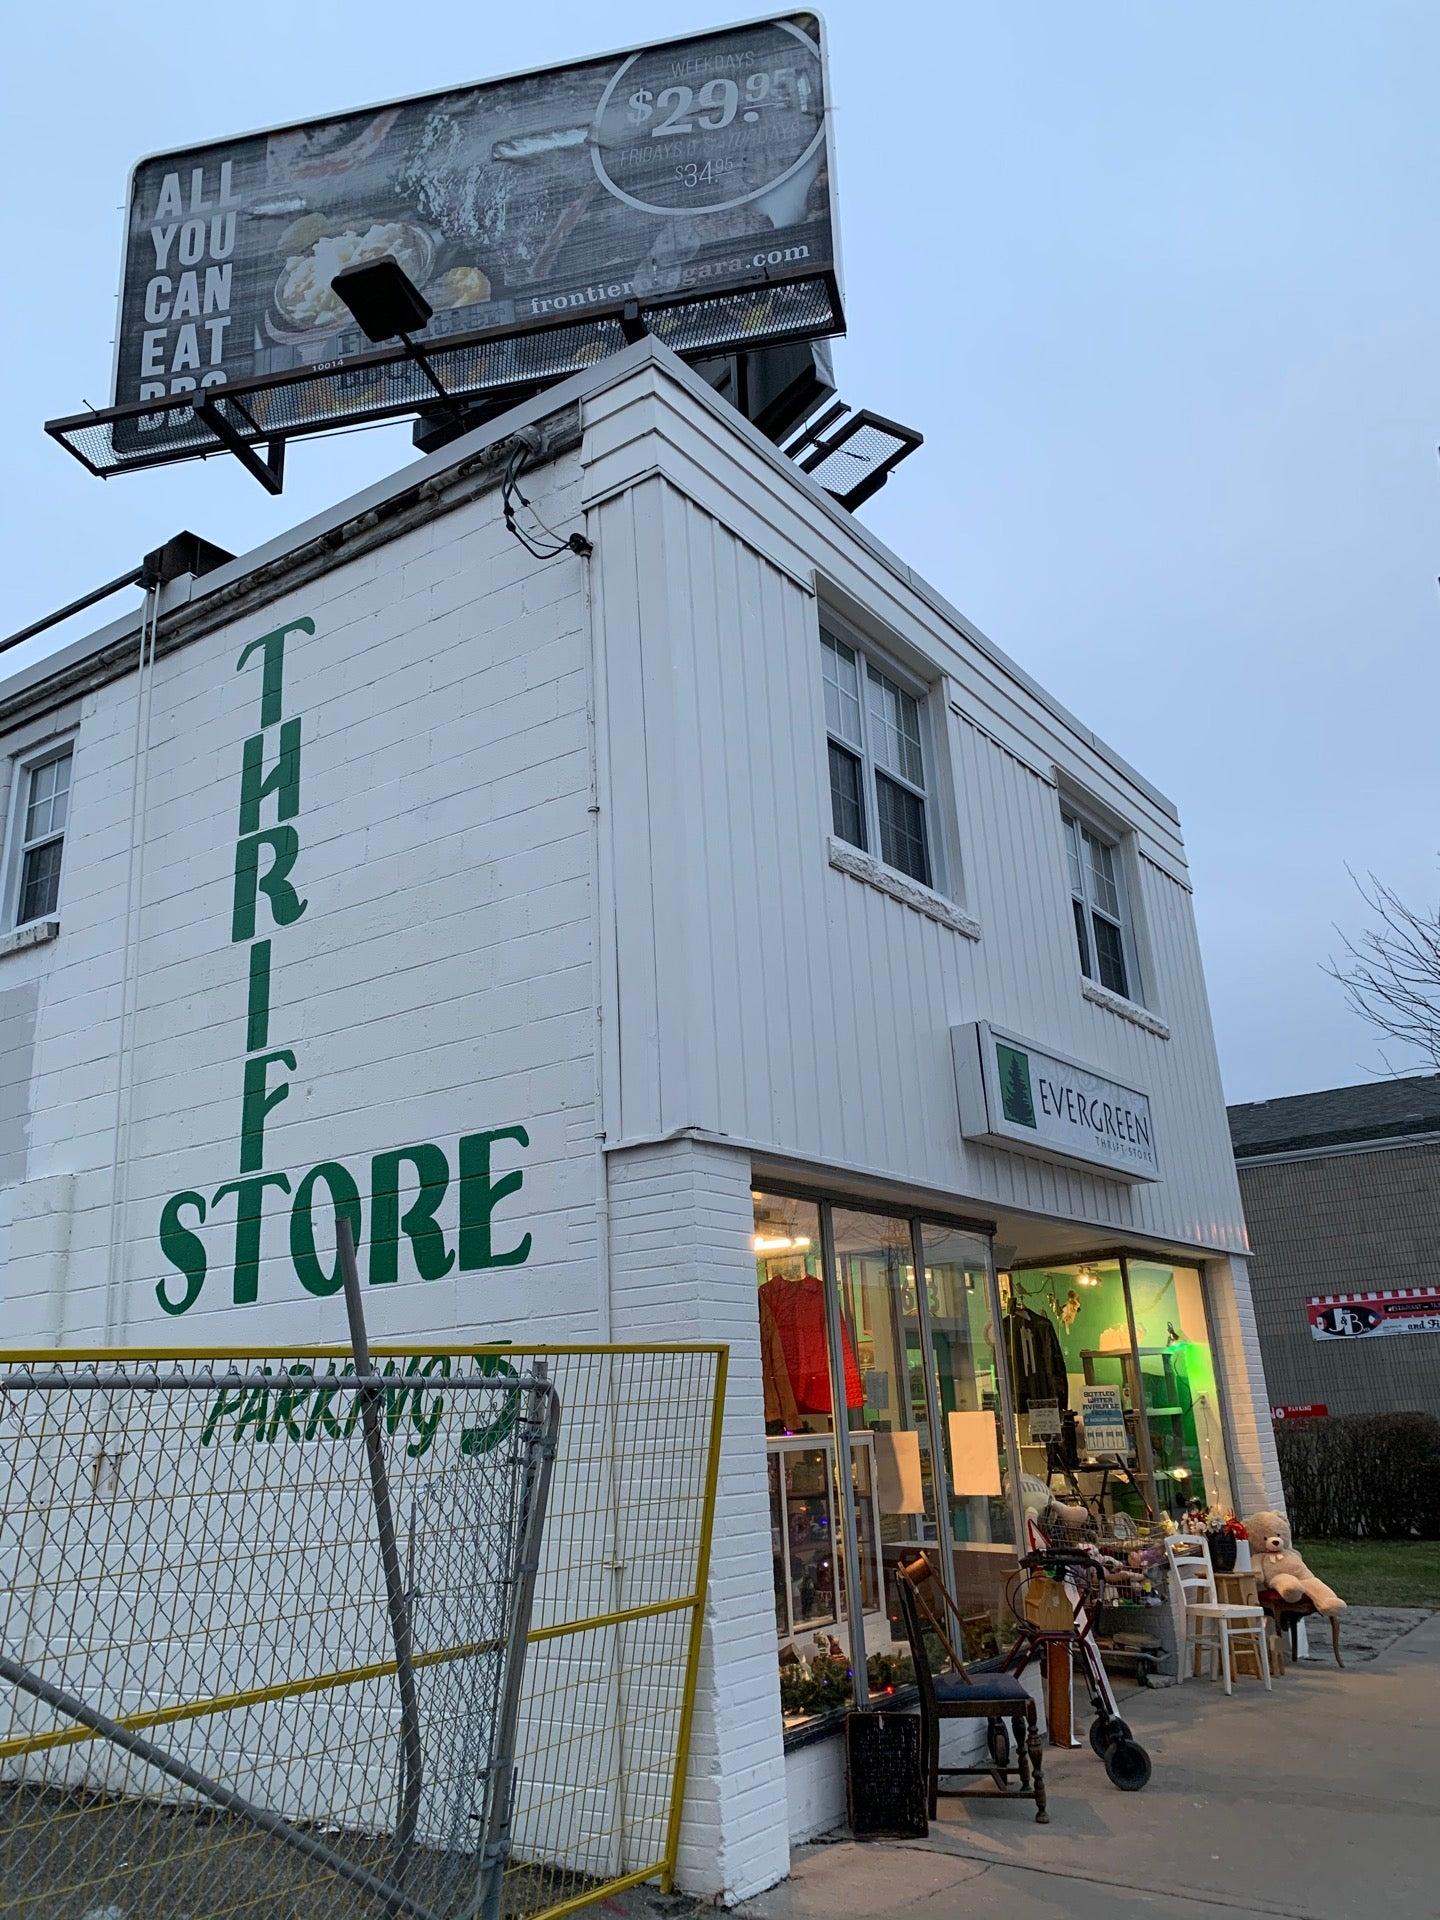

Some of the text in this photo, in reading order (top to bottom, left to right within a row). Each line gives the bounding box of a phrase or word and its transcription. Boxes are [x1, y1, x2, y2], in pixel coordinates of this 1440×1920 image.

[671, 51, 755, 78] WEEKDAYS
[620, 138, 682, 166] FRIDAYS
[675, 156, 734, 188] $34.95
[154, 161, 242, 220] ALL
[151, 212, 237, 270] YOU
[144, 263, 233, 324] CAN
[530, 242, 811, 315] frontiergara.com
[141, 316, 231, 377] EAT
[337, 308, 507, 356] Ftier
[311, 359, 344, 372] 10014
[1039, 1078, 1151, 1147] EVERGREEN
[1094, 1135, 1153, 1163] THRIFT STORE
[155, 1124, 532, 1316] STORE
[1407, 1320, 1426, 1330] and
[200, 1355, 451, 1458] PARKING
